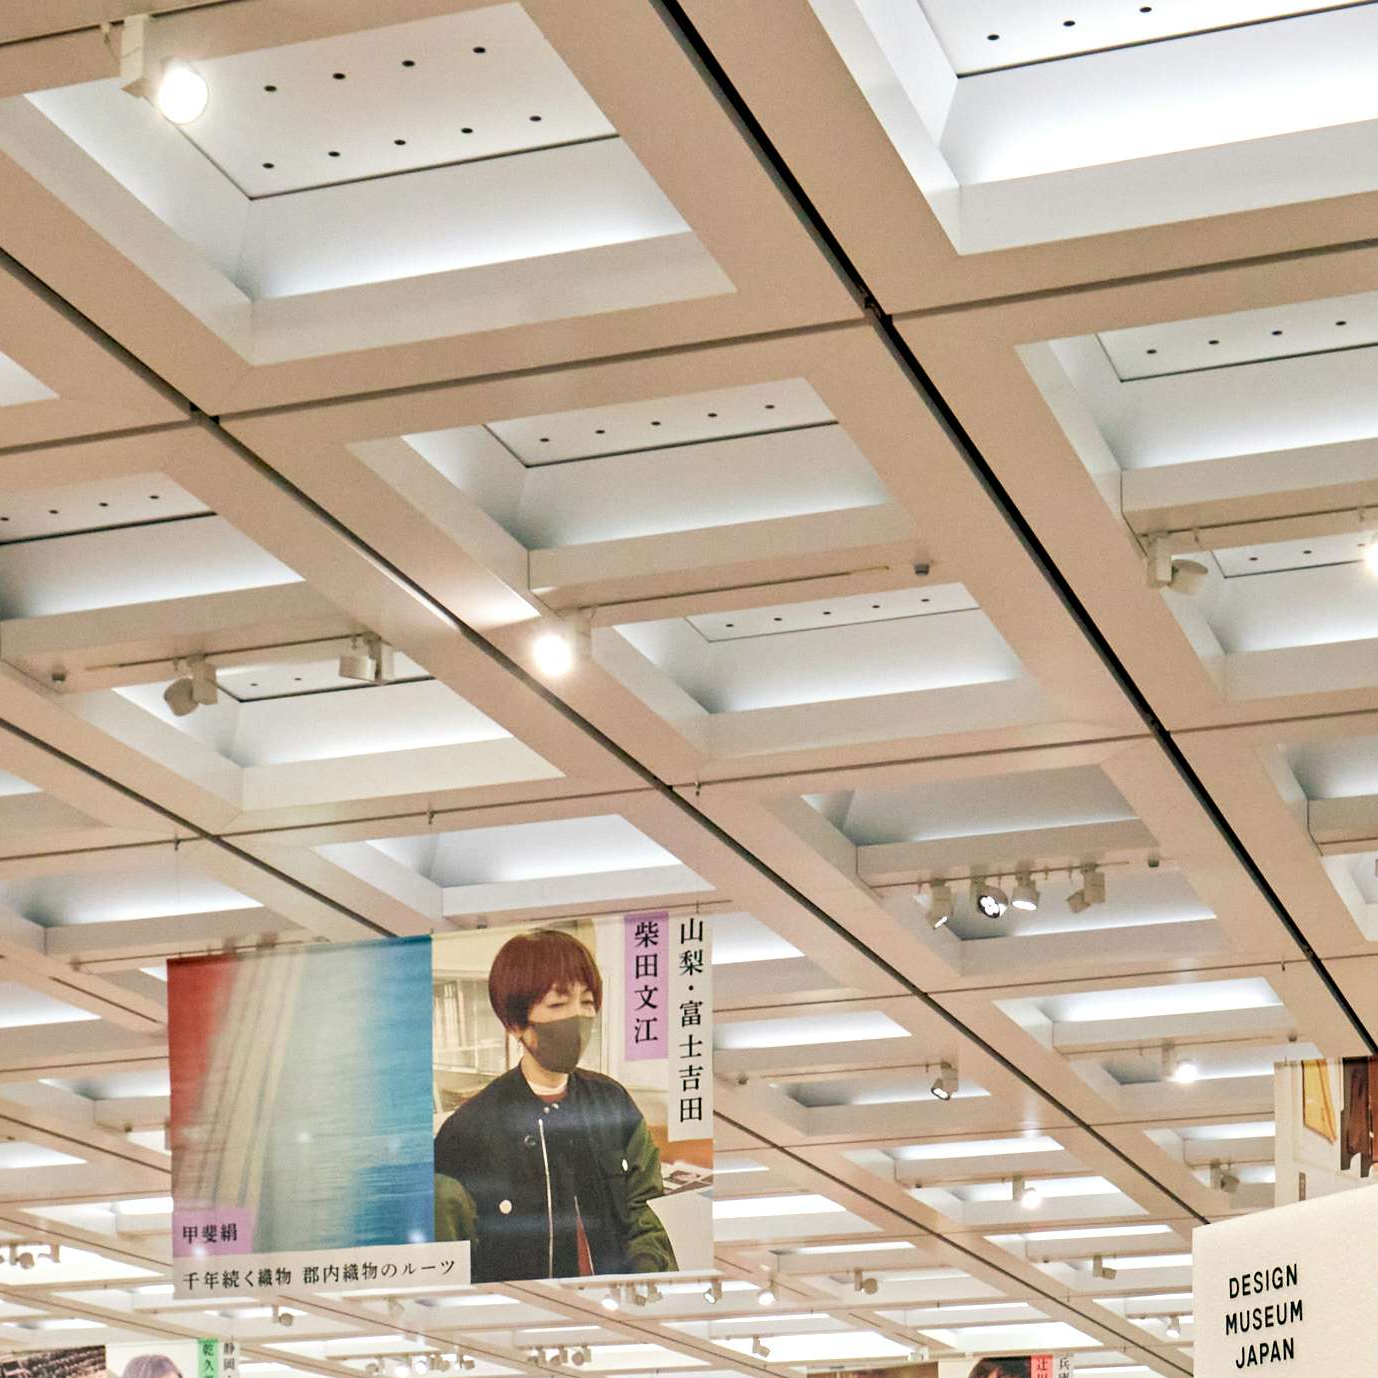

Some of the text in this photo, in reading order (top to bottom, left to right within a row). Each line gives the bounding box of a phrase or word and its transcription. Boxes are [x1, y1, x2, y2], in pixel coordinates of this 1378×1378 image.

[633, 921, 659, 1044] 柴田文江
[679, 918, 704, 1124] 山梨・富士吉田
[181, 1222, 238, 1245] 甲斐絹
[182, 1258, 456, 1290] 千年続く織物 郡内織物のルーツ
[1229, 1263, 1297, 1299] DESIGN
[1226, 1299, 1302, 1336] MUSEUM
[1235, 1337, 1294, 1369] JAPAN
